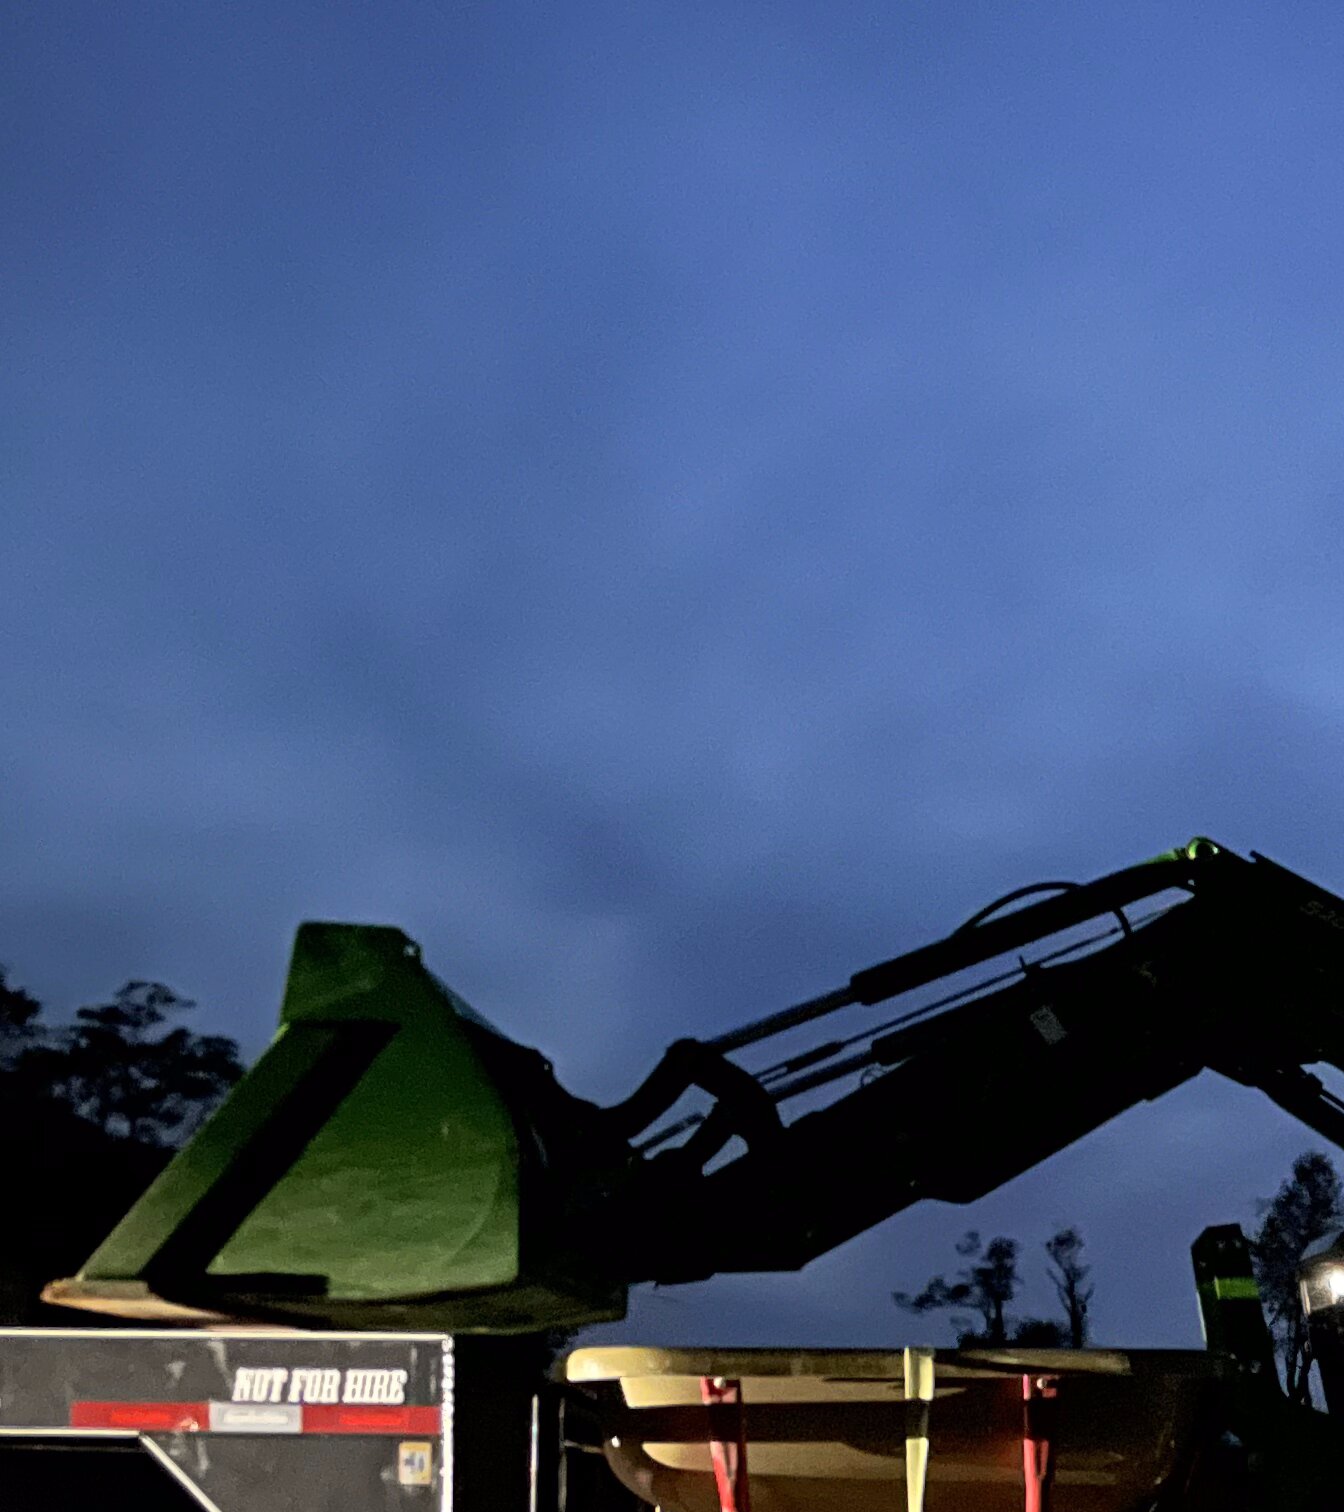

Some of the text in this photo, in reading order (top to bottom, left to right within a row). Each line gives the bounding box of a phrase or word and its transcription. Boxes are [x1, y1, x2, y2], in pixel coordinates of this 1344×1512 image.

[232, 1367, 408, 1404] NOT FOR HIRE
